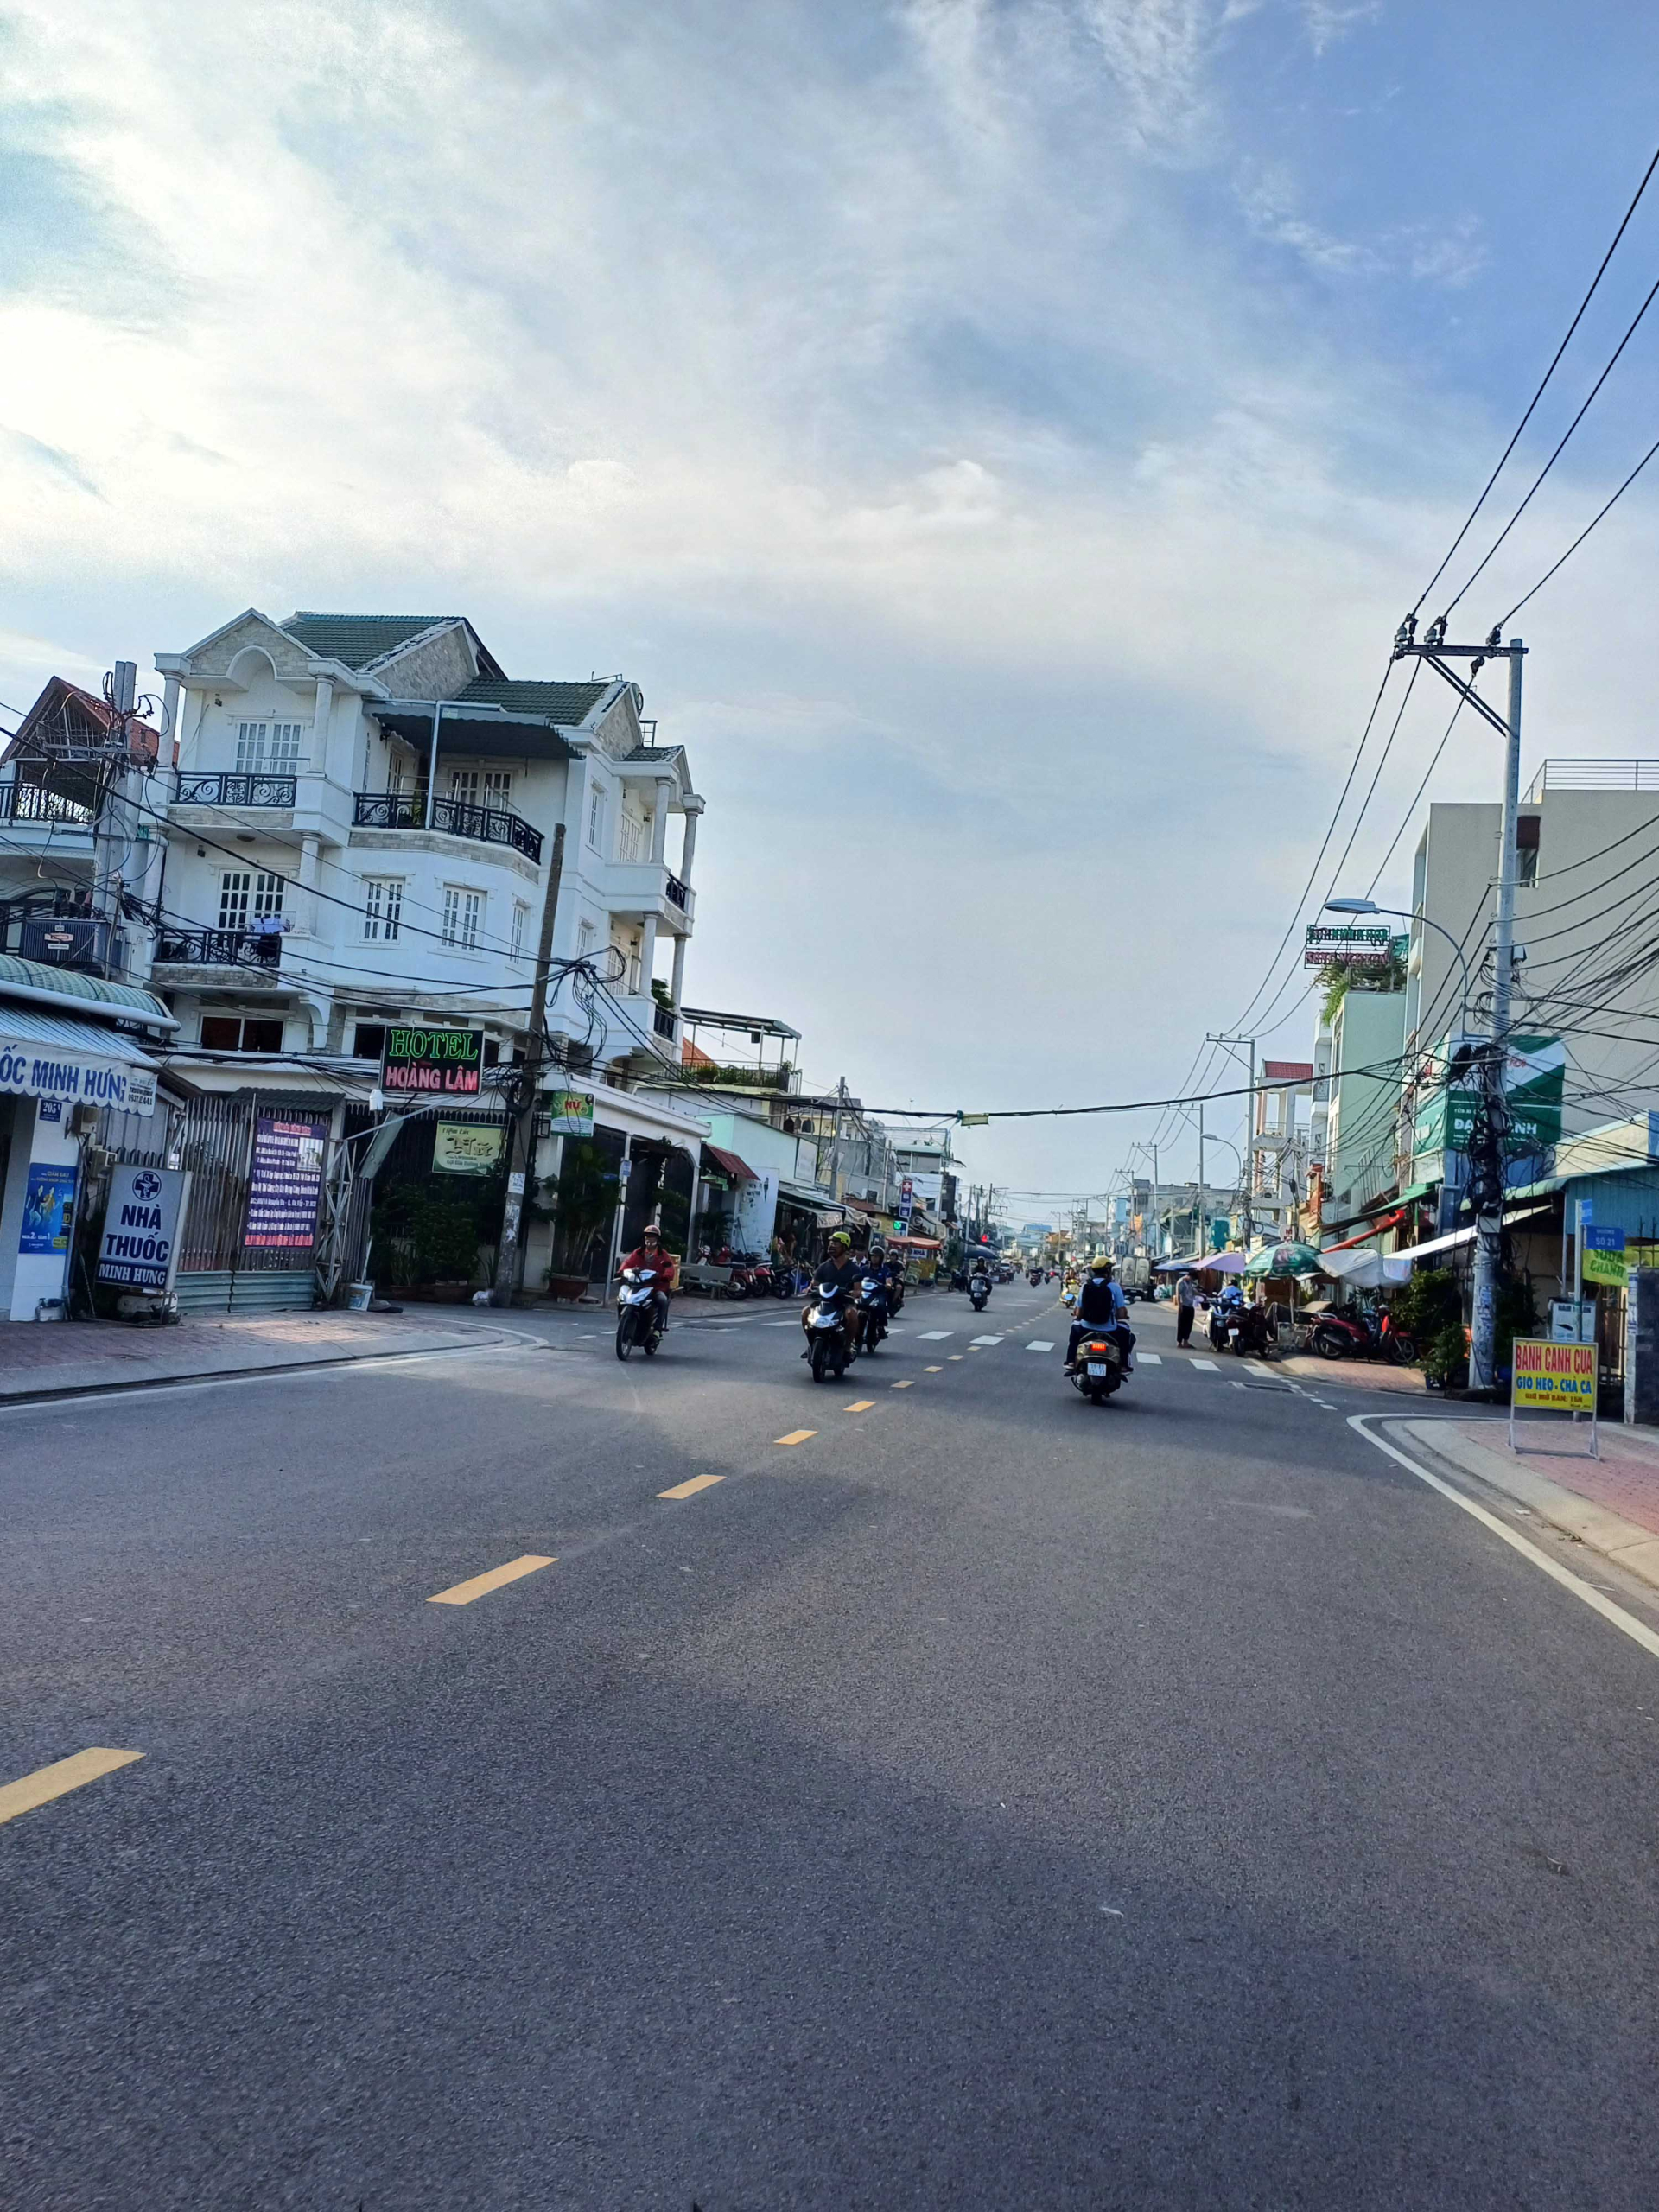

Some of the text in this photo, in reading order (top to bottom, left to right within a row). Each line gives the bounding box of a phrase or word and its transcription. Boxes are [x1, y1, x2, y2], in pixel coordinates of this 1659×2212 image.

[389, 1029, 479, 1060] HOTEL
[31, 1059, 79, 1094] MINH
[84, 1068, 127, 1103] HƯNG
[385, 1062, 478, 1090] HOÀNG LÂM
[120, 1204, 162, 1230] NHÀ
[106, 1232, 169, 1262] THUỐC
[1607, 1237, 1616, 1246] 21
[99, 1264, 131, 1281] MINH
[1545, 1347, 1571, 1373] CANH
[1573, 1349, 1593, 1374] CUA
[1535, 1377, 1554, 1390] HEO
